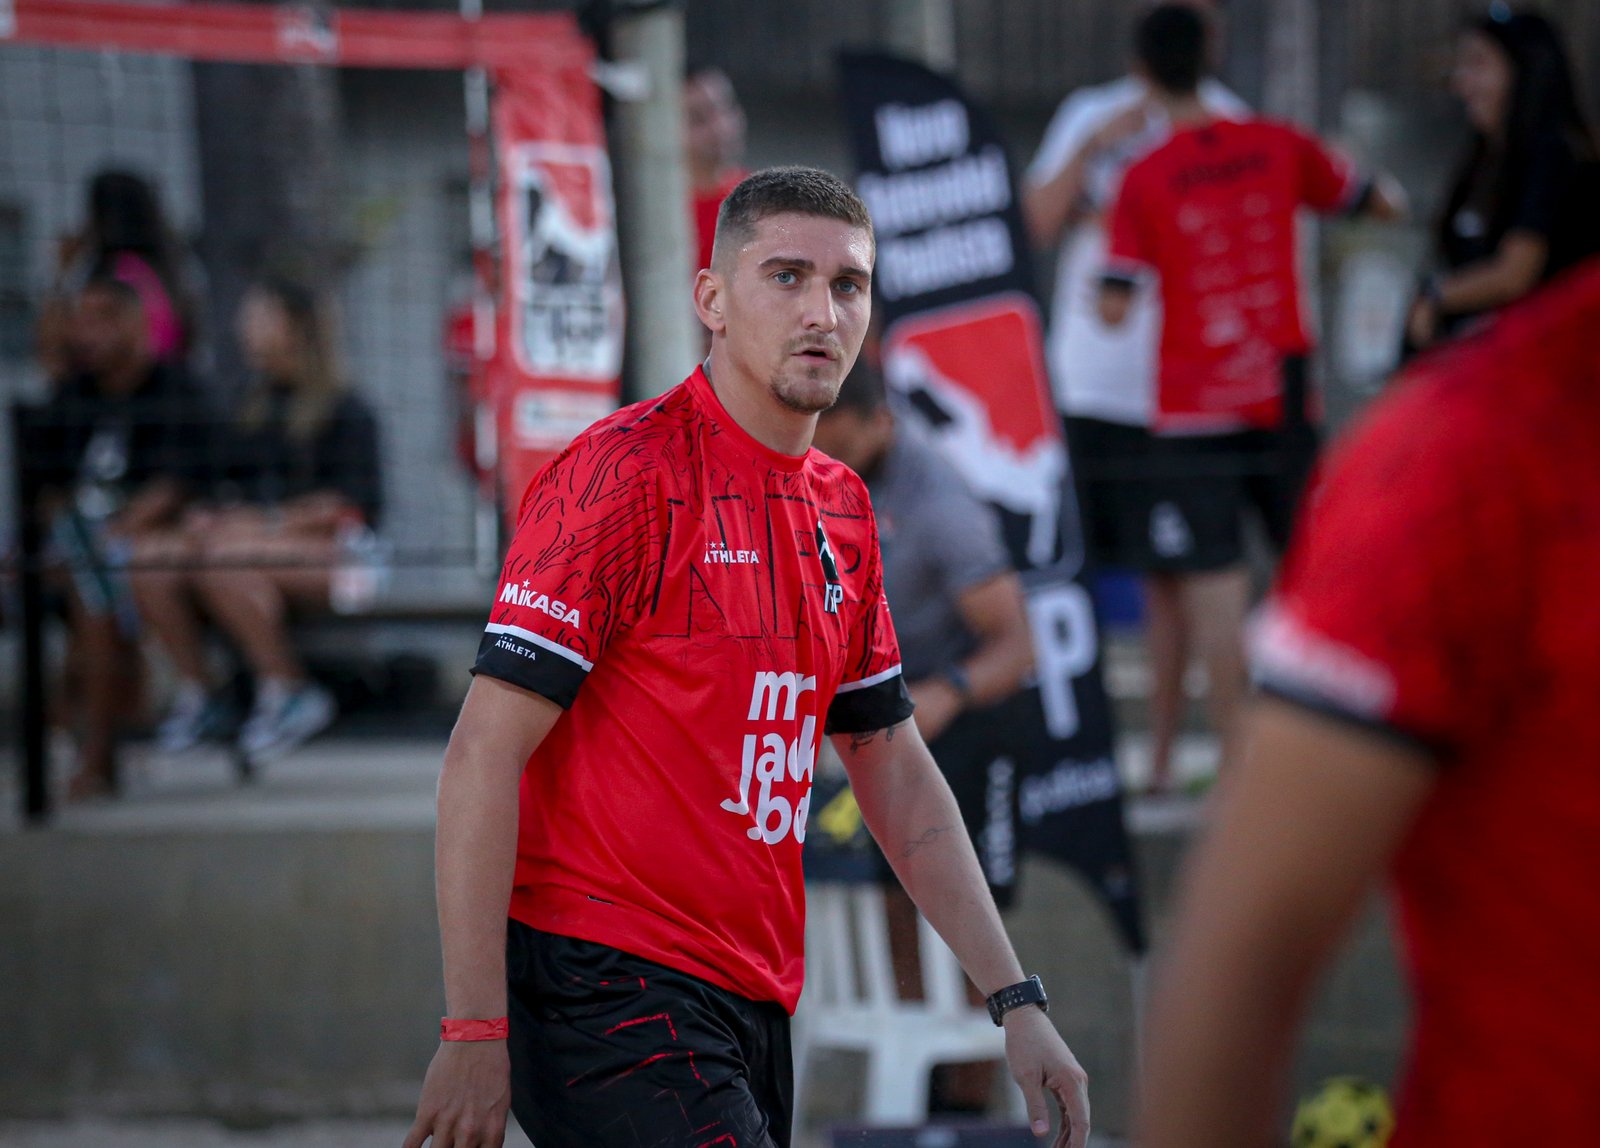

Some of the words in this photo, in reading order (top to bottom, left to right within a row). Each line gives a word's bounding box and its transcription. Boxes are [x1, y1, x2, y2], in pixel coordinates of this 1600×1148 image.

[704, 550, 760, 564] ATHLETA
[495, 639, 536, 661] ATHLETA
[747, 671, 817, 721] mr
